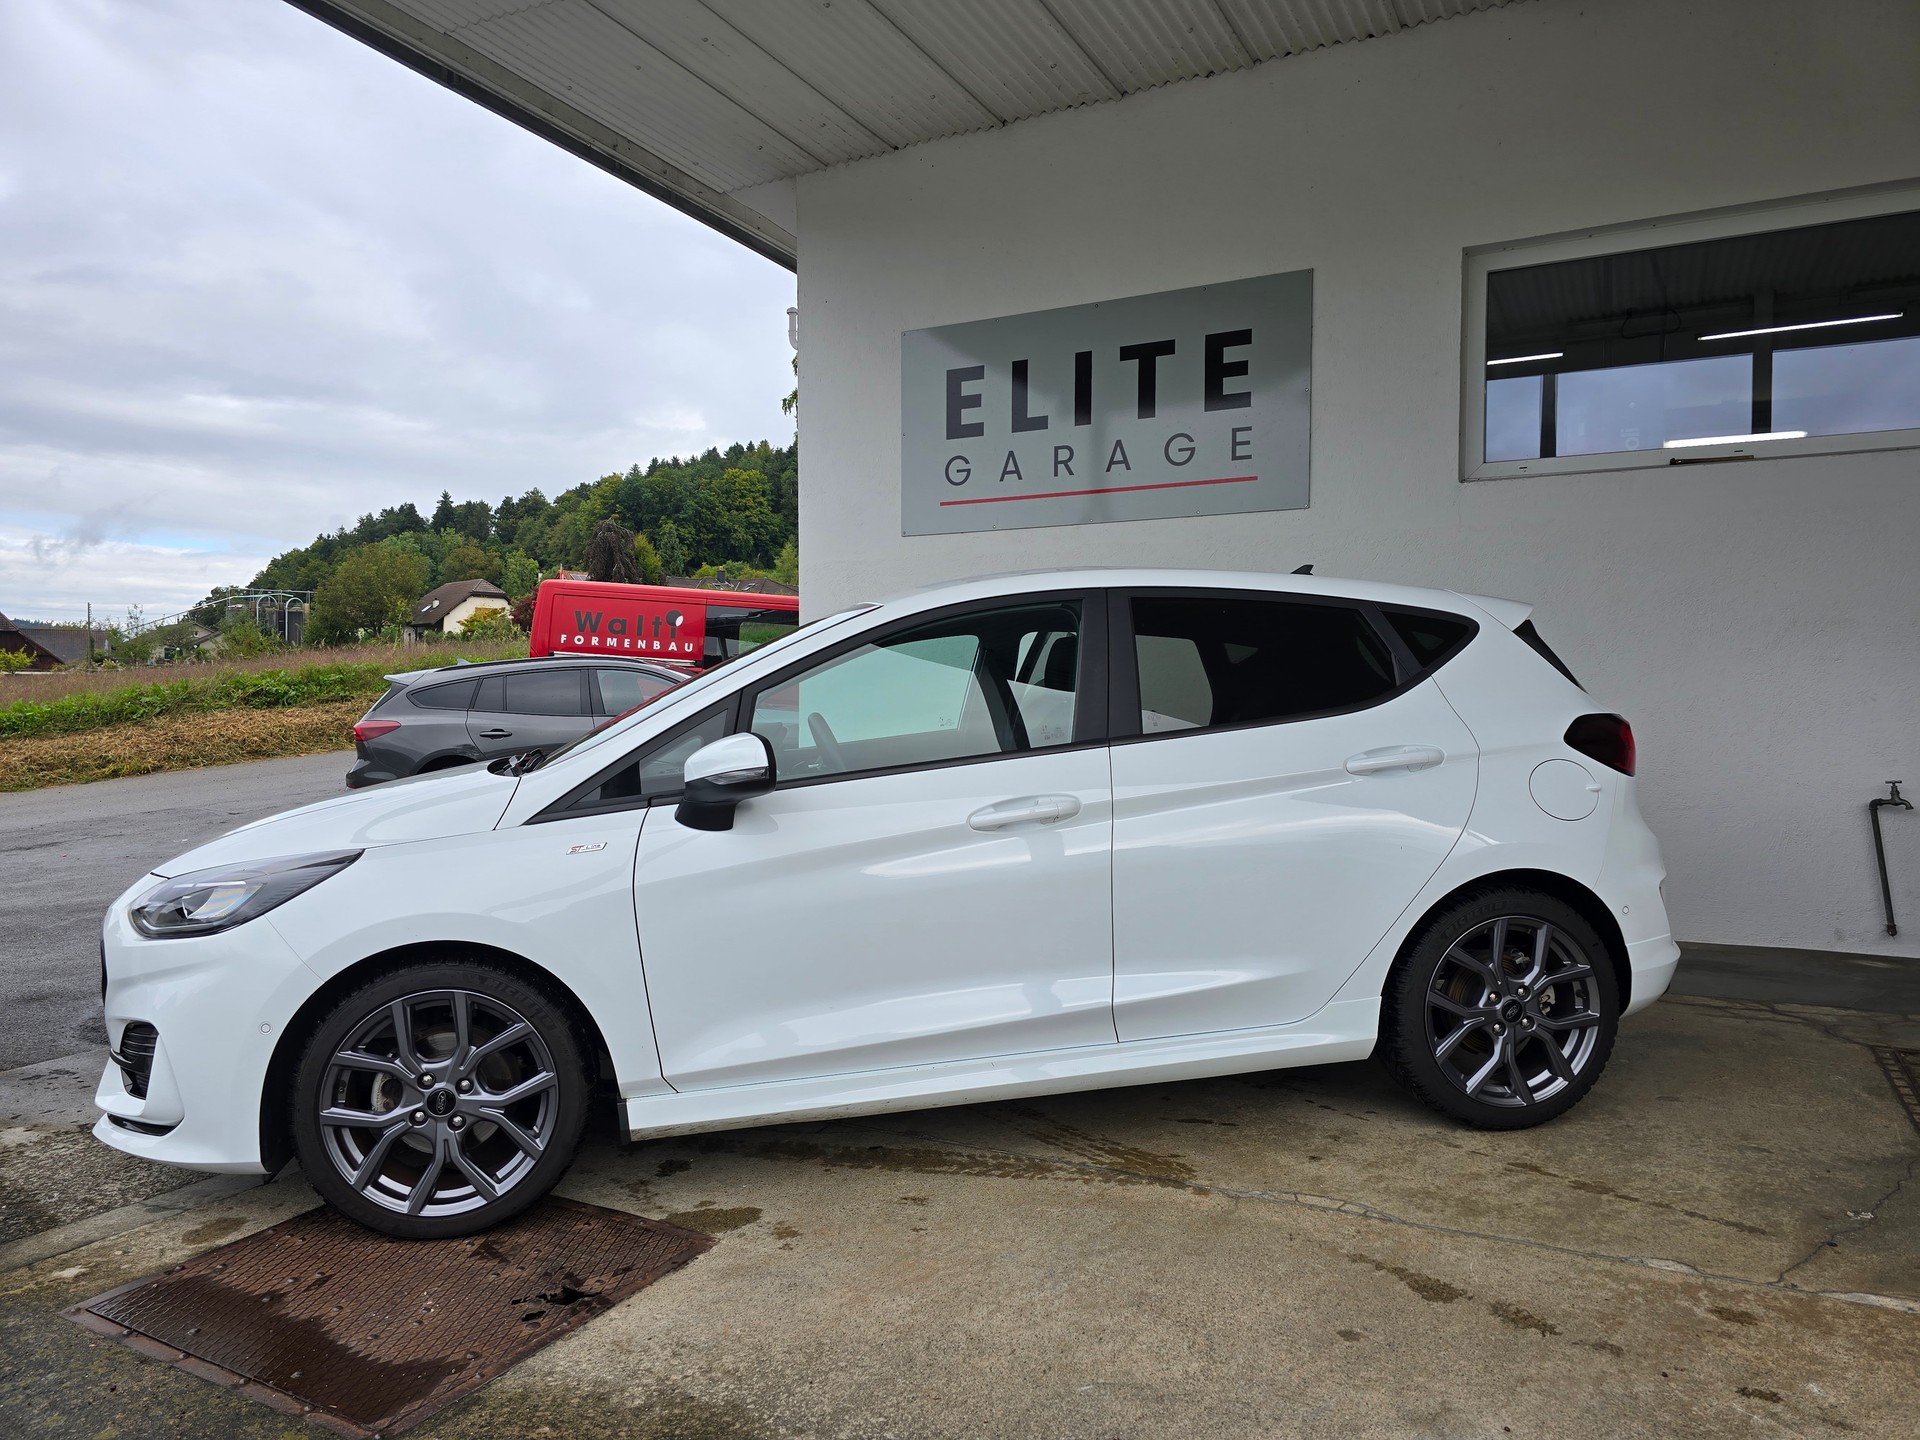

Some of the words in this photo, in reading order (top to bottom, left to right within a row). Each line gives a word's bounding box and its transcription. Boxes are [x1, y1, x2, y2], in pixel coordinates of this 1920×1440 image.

[946, 328, 1253, 440] ELITE
[944, 426, 1253, 486] GARAGE
[561, 634, 694, 652] FORMENBAU
[575, 611, 684, 638] Walti
